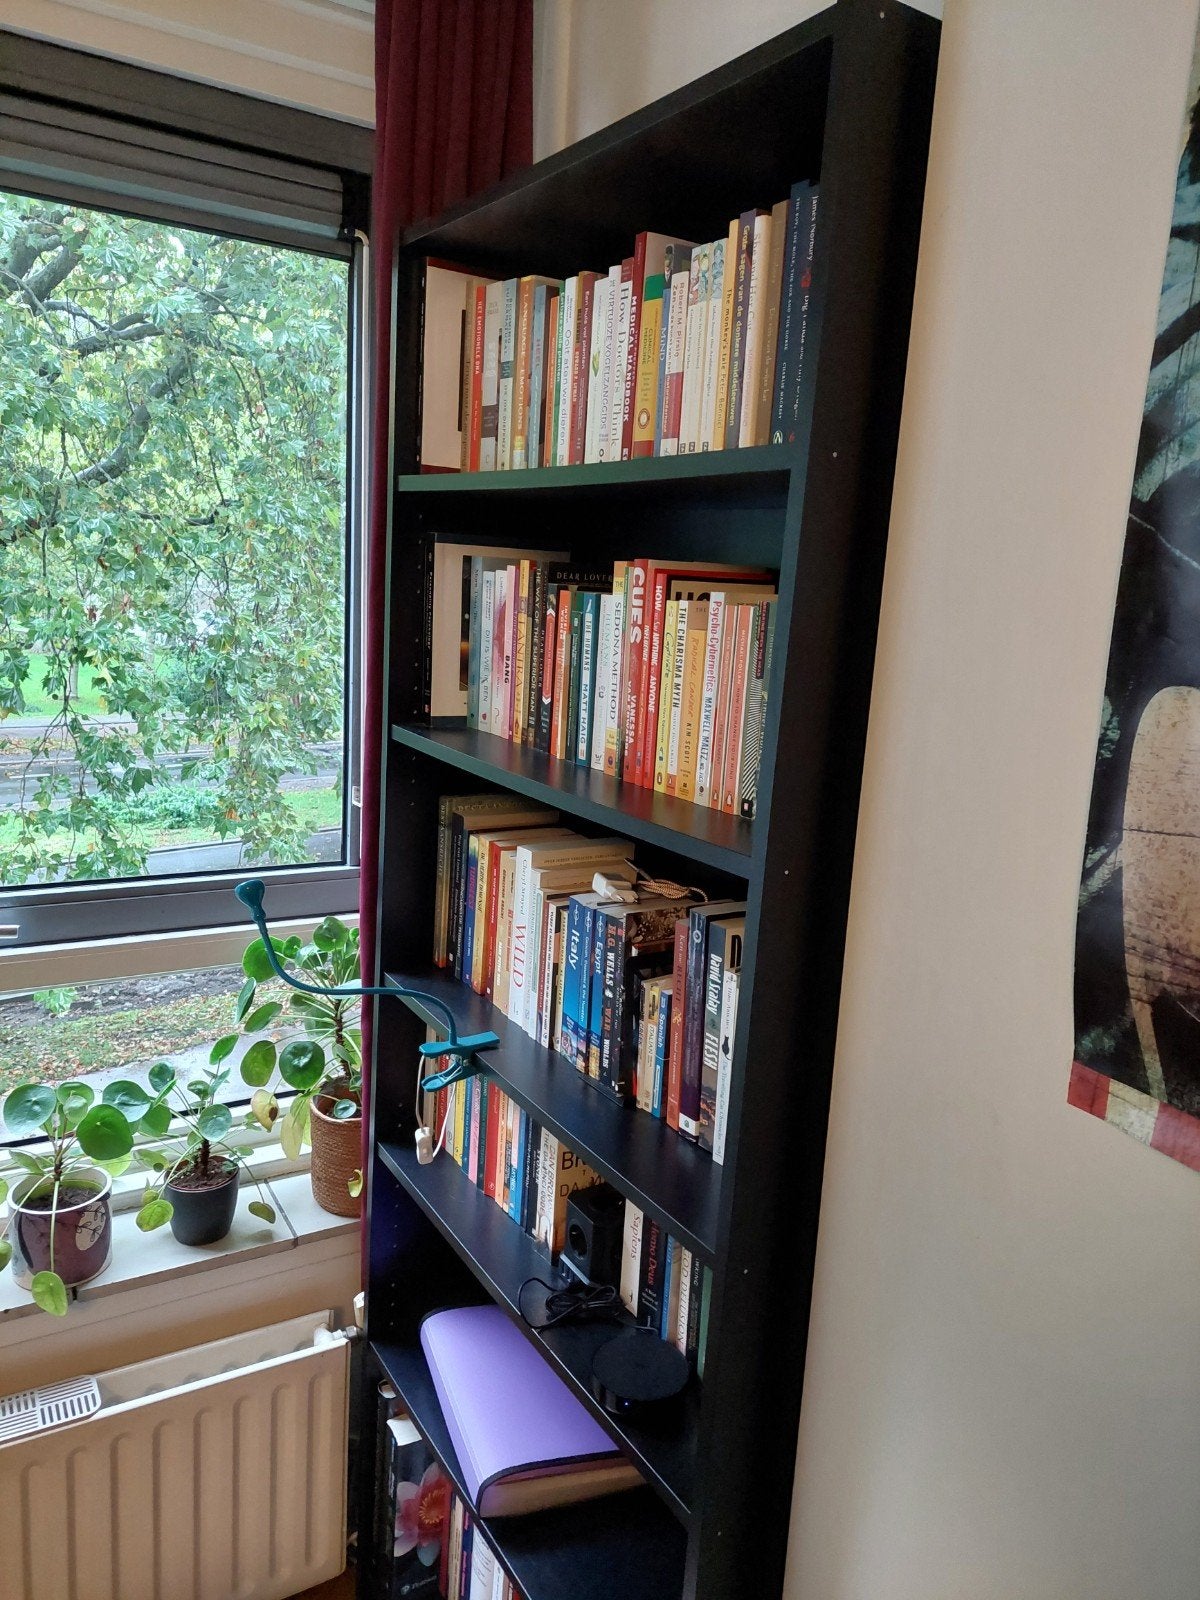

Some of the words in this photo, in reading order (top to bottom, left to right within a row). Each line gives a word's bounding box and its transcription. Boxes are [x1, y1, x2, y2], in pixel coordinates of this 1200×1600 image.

[811, 195, 819, 222] James
[742, 224, 750, 251] Grote
[739, 253, 748, 282] sagen
[605, 289, 616, 341] VIRTUOZE
[618, 286, 630, 325] How
[677, 282, 685, 314] Robert
[736, 305, 744, 317] de
[520, 293, 528, 356] LANGUAGE
[628, 295, 638, 348] MEDICAL
[676, 316, 682, 328] M.
[734, 320, 743, 358] donkere
[614, 331, 627, 394] Doctors
[674, 330, 682, 358] Pirsig
[518, 369, 526, 430] EMOTIONS
[562, 387, 568, 406] we
[600, 343, 612, 430] VOGELZANGGIDS
[623, 354, 634, 423] HANDBOOK
[730, 360, 740, 427] middeleeuwen
[560, 408, 568, 446] dieren
[610, 397, 622, 447] Think
[556, 572, 580, 581] DEAR
[630, 567, 645, 644] CUES
[654, 584, 662, 612] HOW
[678, 606, 687, 625] THE
[534, 610, 540, 625] OF
[612, 601, 621, 657] SEDONA
[516, 618, 526, 689] TANTRA
[652, 632, 660, 667] ANYTHING
[664, 633, 674, 679] Captivate
[674, 628, 685, 678] CHARISMA
[690, 636, 700, 678] RADICAL
[706, 600, 722, 693] Psycho-Cybernetics
[610, 661, 619, 721] METHOD
[648, 675, 656, 715] ANYONE
[672, 682, 681, 709] MYTH
[688, 681, 697, 718] CANDOR
[629, 695, 637, 744] VANESSA
[702, 696, 713, 734] MAXWELL
[700, 734, 710, 761] MALTZ
[568, 928, 580, 970] Italy
[606, 923, 616, 949] H.G.
[512, 923, 526, 989] WILD
[605, 951, 615, 987] WELLS
[710, 953, 722, 983] David
[706, 981, 721, 1016] Szalay
[604, 1006, 612, 1032] WAR
[658, 1012, 666, 1048] Spanish
[602, 1037, 610, 1069] WORLDS
[648, 1024, 657, 1055] ITALIAN
[704, 1031, 719, 1071] FLESH
[543, 1150, 548, 1163] DA
[630, 1212, 642, 1261] Sapiens
[650, 1221, 660, 1257] Homo
[648, 1257, 658, 1286] Deus
[677, 1280, 688, 1346] DELUSION
